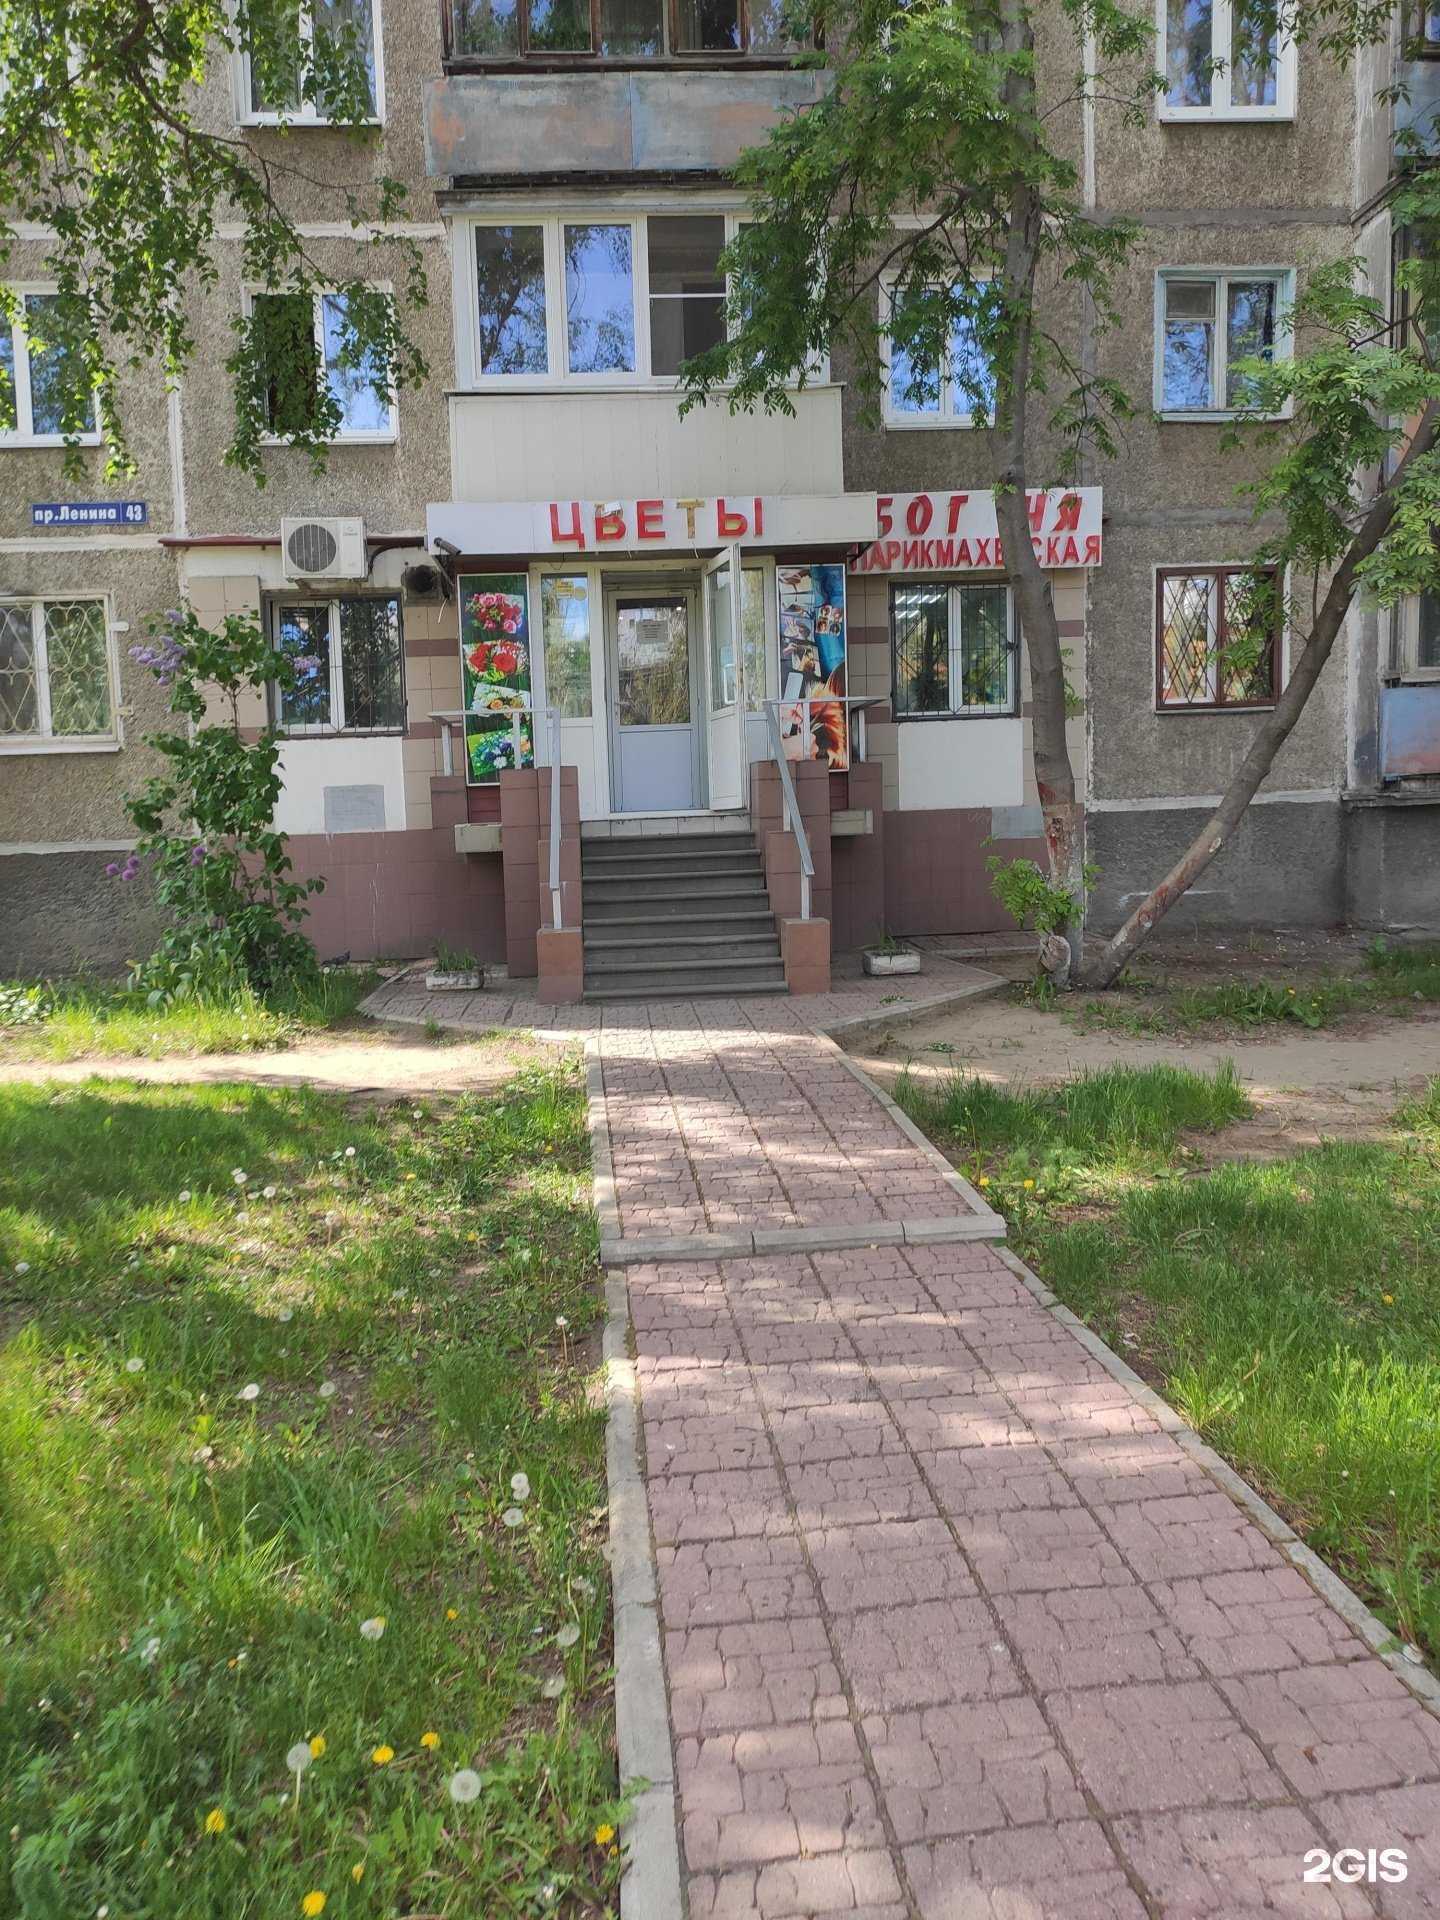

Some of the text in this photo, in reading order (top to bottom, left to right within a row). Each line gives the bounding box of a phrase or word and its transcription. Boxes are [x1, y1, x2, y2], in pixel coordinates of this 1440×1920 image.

[126, 505, 143, 521] 43
[549, 498, 763, 550] ЦВЕТЫ
[877, 494, 1083, 538] БОГНЯ
[849, 535, 1102, 571] ПАРИКМАХЕСКАЯ
